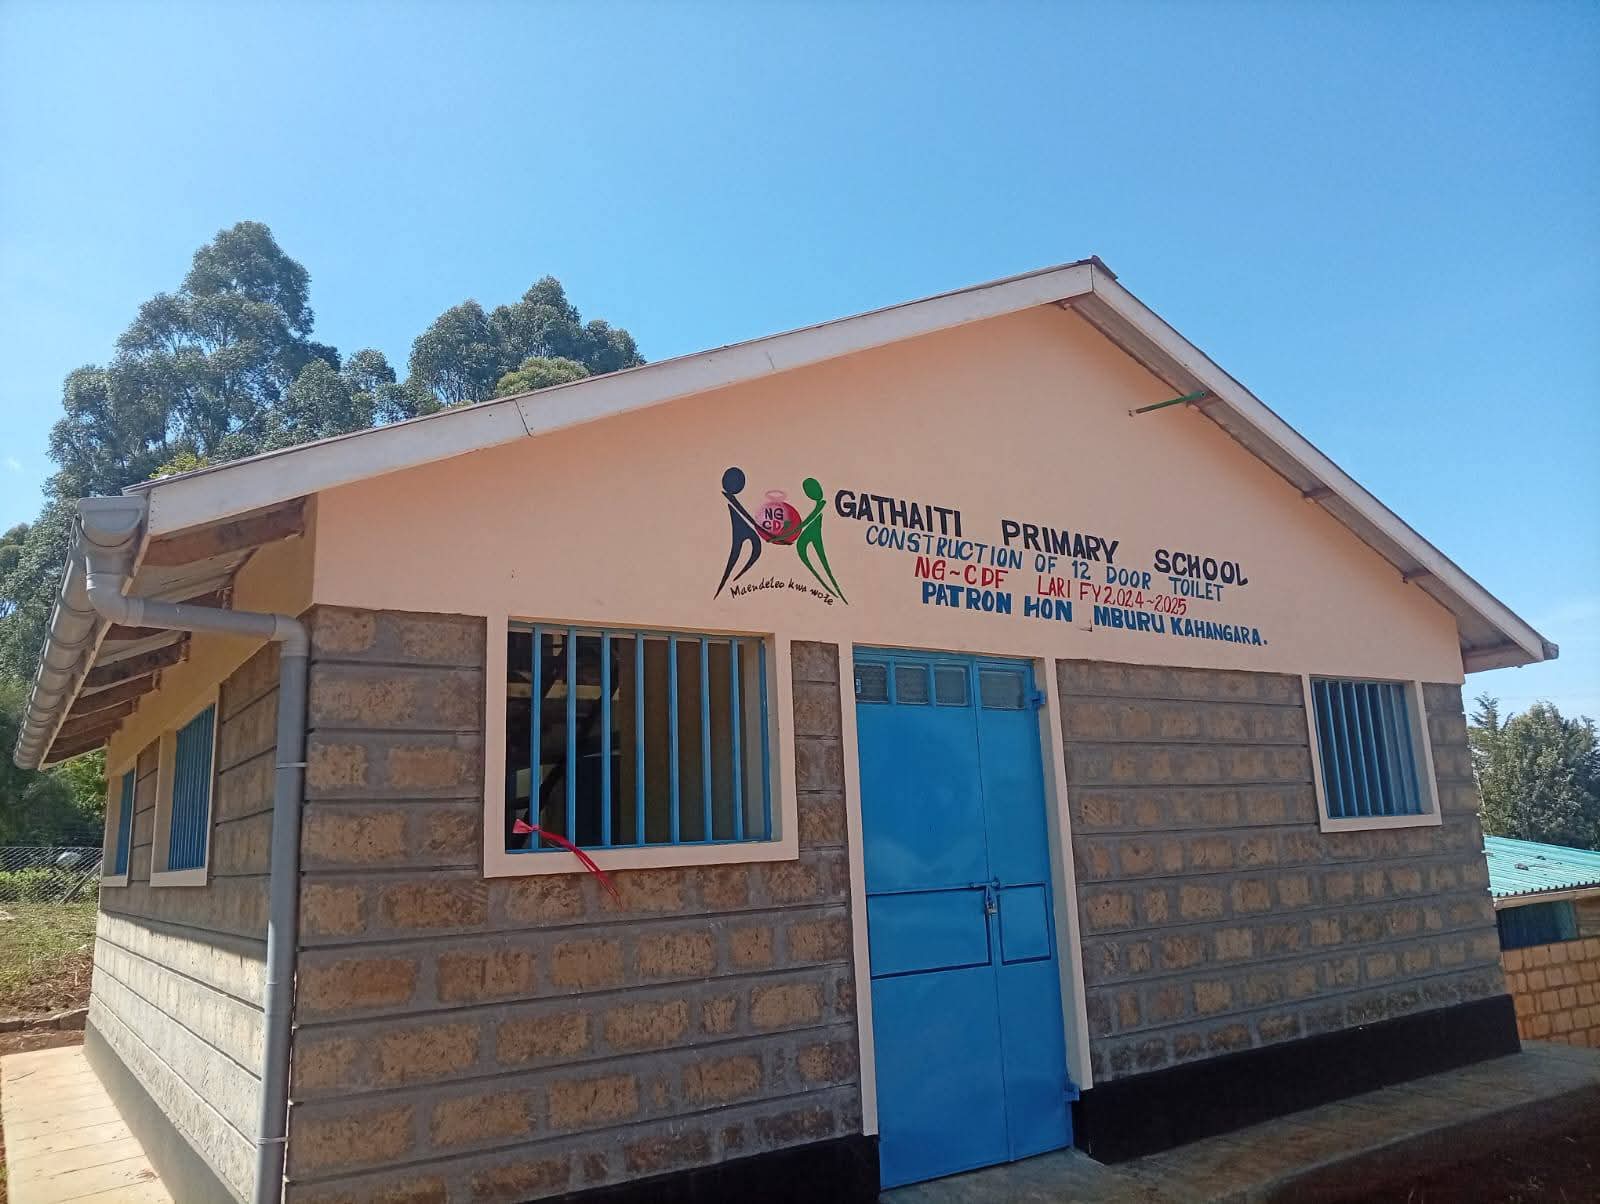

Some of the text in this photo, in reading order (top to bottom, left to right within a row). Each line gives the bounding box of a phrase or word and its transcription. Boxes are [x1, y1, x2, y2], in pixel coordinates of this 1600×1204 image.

[764, 507, 784, 520] NG
[834, 489, 1249, 587] GATHAITI PRIMARY SCHOOL
[865, 525, 1225, 602] CONSTRUCTION OF 12 DOOR TOILET
[1037, 575, 1072, 599] LARI
[921, 581, 1268, 647] PATRON HON MBURU KAHANGARA.
